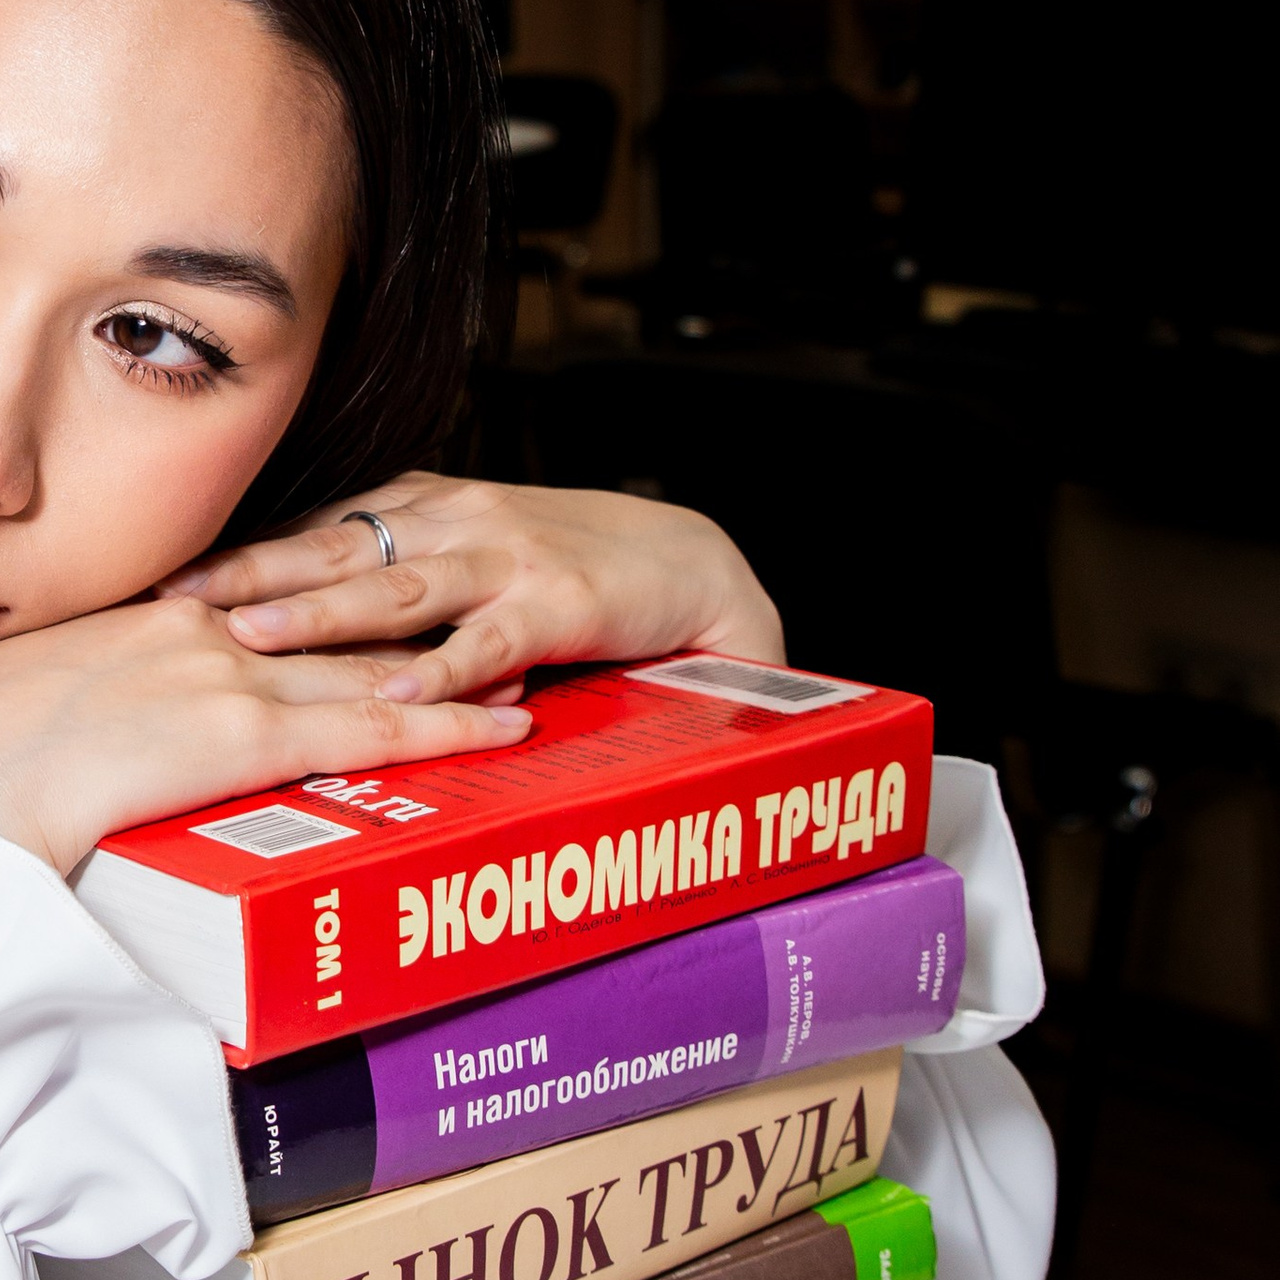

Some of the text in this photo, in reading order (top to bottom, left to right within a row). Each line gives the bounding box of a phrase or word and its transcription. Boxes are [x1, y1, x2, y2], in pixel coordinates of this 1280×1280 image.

[398, 804, 742, 968] ЭКОНОМИКА
[756, 761, 906, 869] ТРУДА
[568, 913, 622, 935] Одегов
[660, 886, 717, 912] Руденко
[764, 853, 830, 882] Бабынина
[314, 888, 342, 1011] ТОМ 1
[434, 1034, 548, 1089] Налоги
[781, 974, 800, 1064] ТОЛКУШКИН
[437, 1032, 738, 1136] и налогообложение
[263, 1104, 282, 1176] ЮРАЙТ
[638, 1085, 870, 1252] ТРУДА
